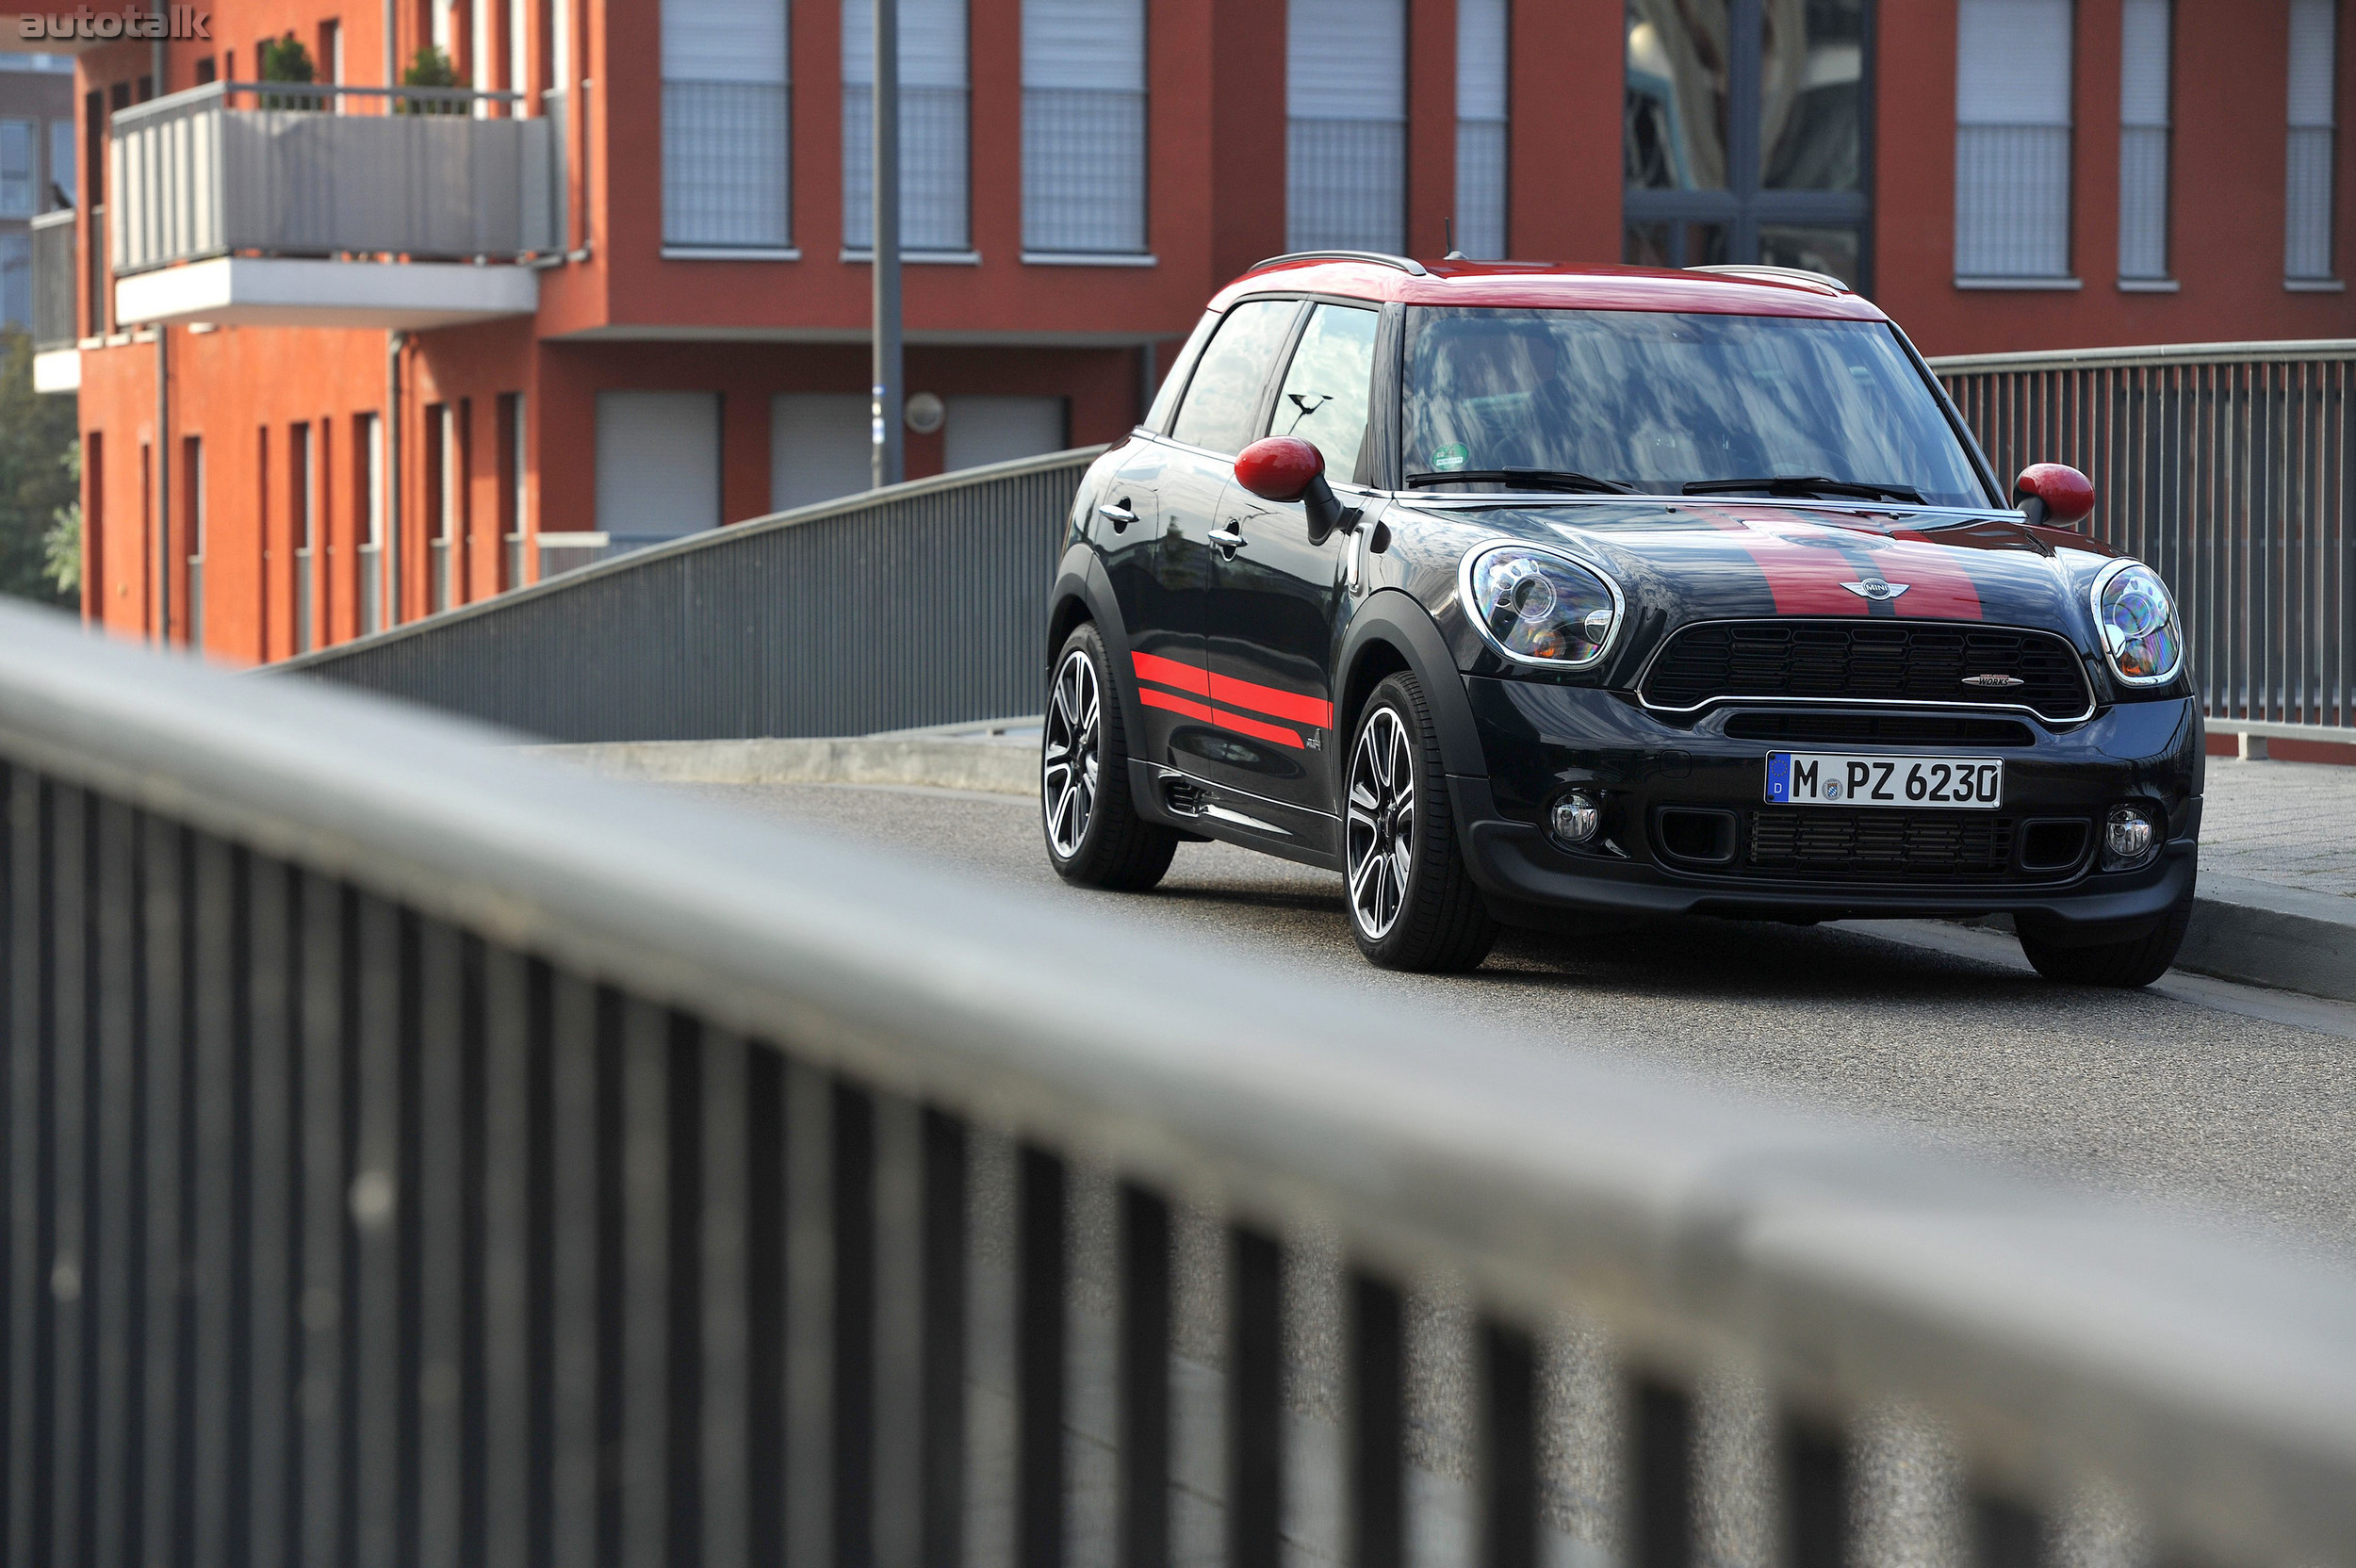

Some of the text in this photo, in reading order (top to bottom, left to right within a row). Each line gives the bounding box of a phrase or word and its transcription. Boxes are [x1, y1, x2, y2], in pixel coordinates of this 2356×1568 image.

[1774, 782, 1782, 793] D
[1792, 760, 1819, 798] M
[1846, 760, 1895, 800] PZ
[1905, 762, 1998, 803] 6230
